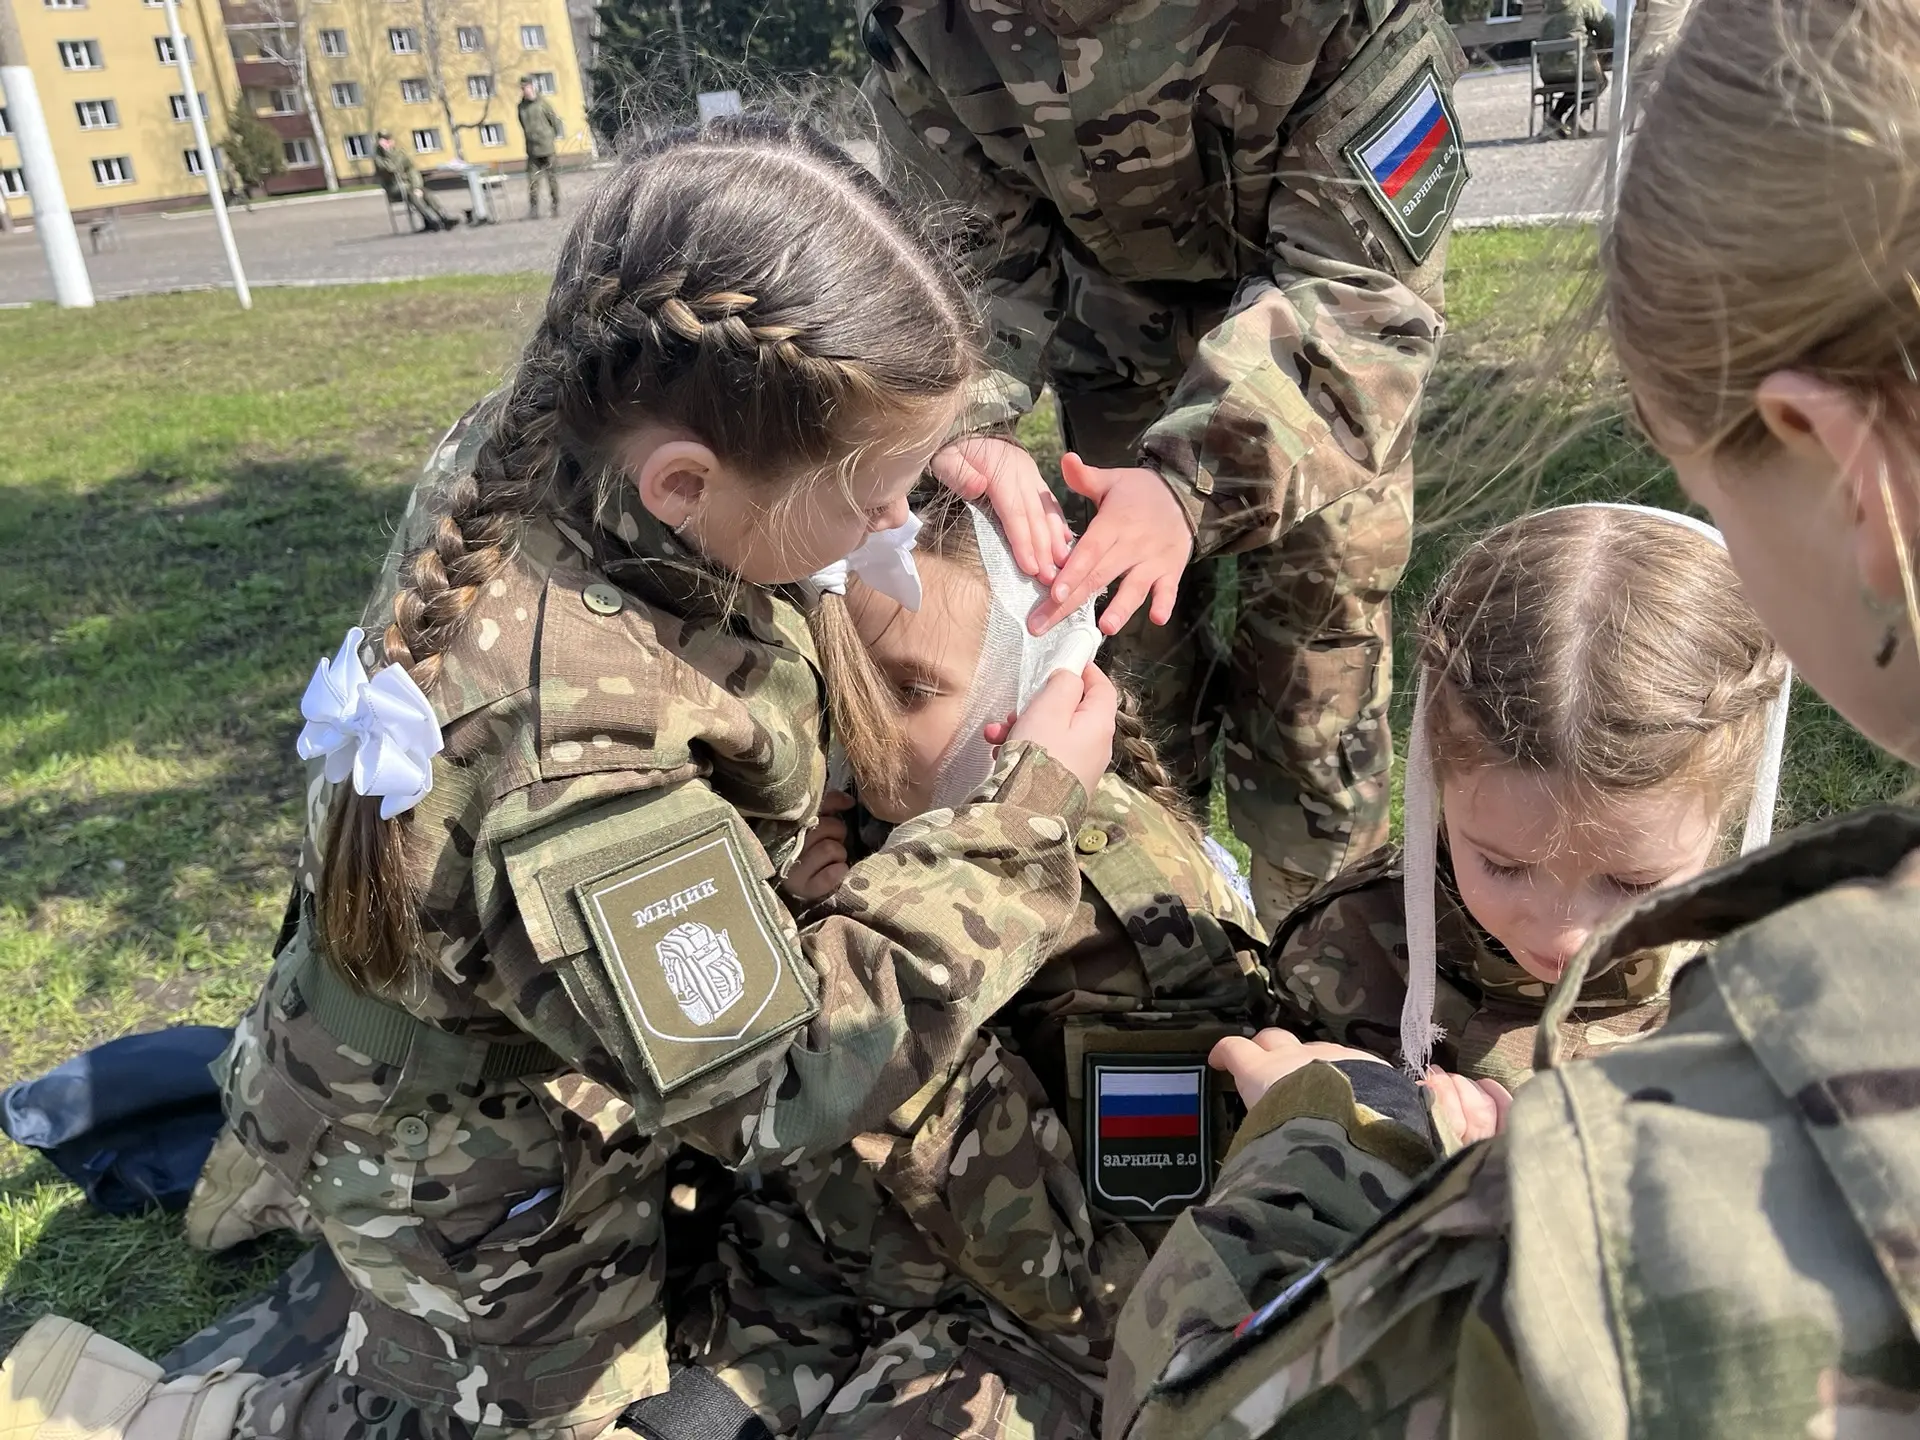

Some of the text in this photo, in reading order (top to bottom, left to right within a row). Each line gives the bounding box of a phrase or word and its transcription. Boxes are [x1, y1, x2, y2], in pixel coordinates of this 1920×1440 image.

[1402, 163, 1445, 216] ЗАРНИЦА
[632, 877, 718, 929] МЕДИК
[1103, 1153, 1197, 1169] ЗАРНИЦА 2.0
